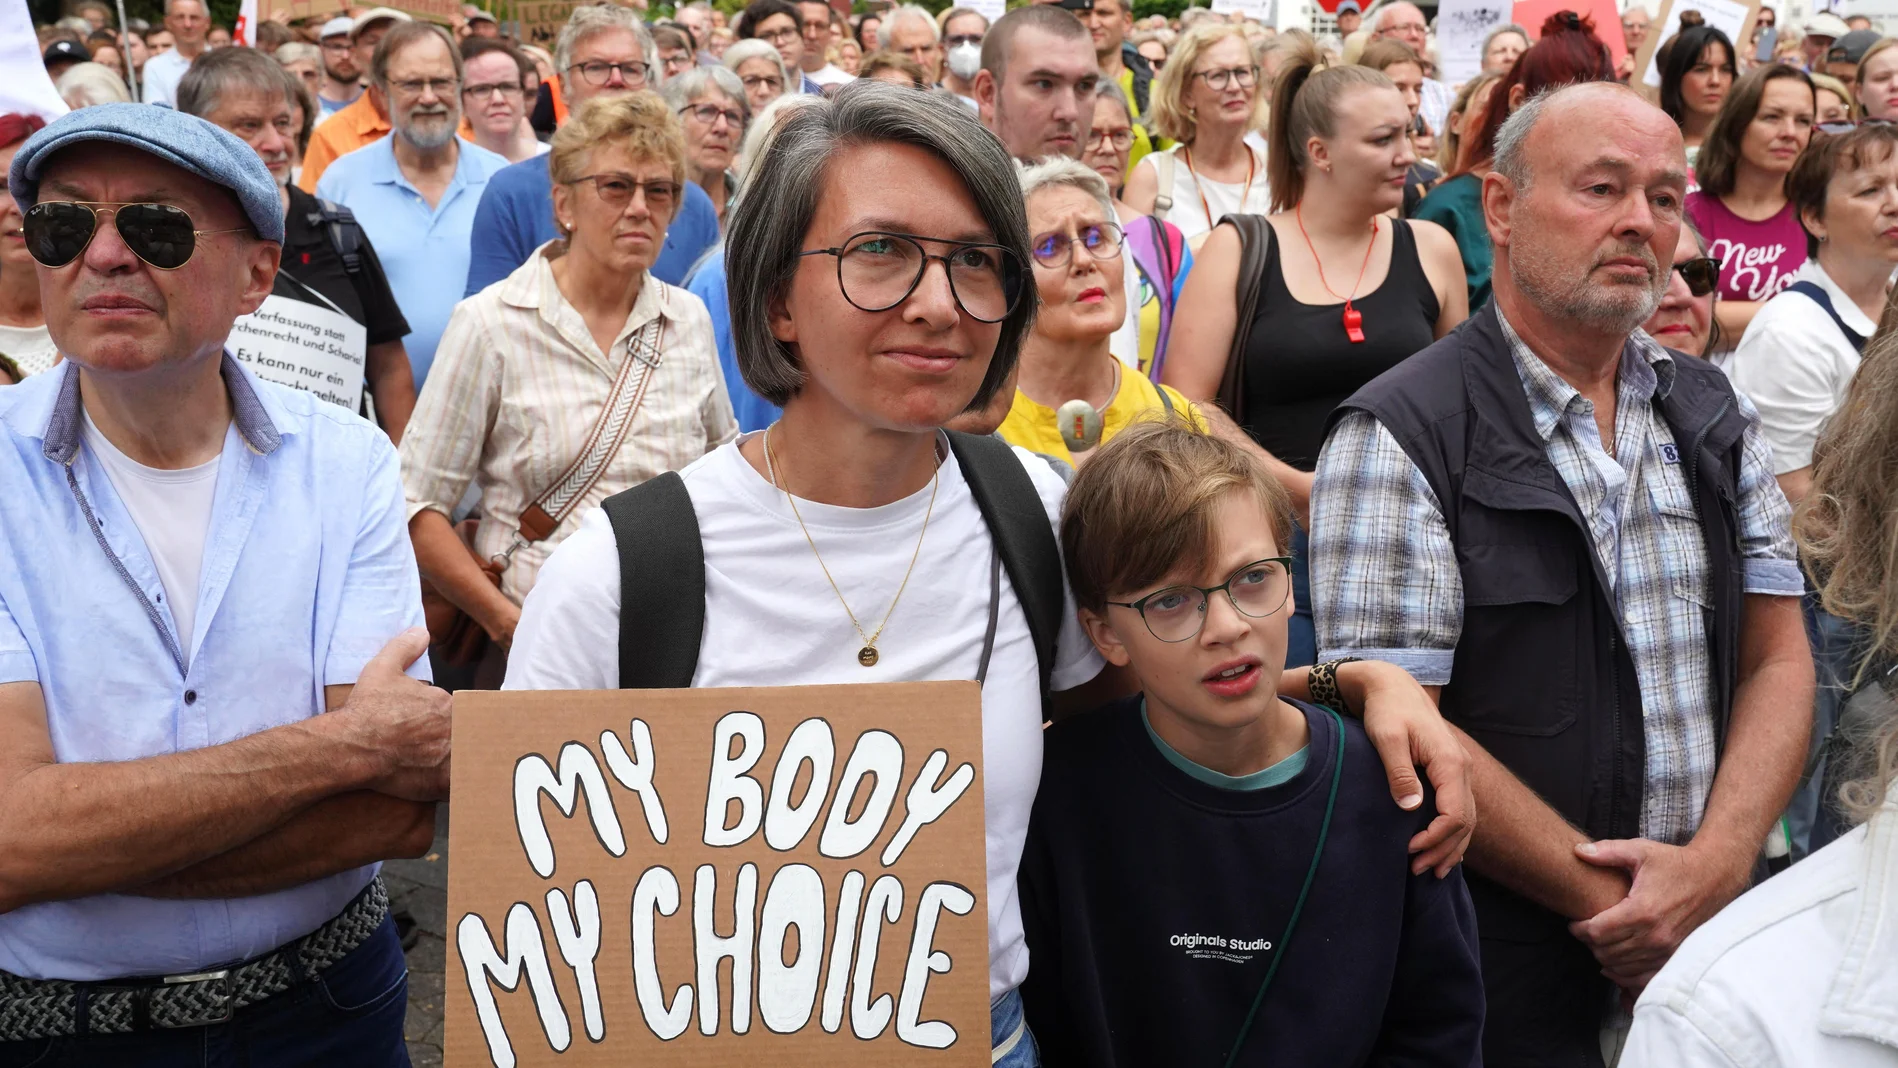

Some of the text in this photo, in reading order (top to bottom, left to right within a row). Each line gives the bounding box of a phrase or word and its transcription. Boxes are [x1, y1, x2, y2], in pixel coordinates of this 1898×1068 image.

[1707, 239, 1786, 273] New
[1730, 266, 1799, 301] Yo
[253, 310, 346, 342] Verfassung statt
[303, 341, 325, 351] und
[237, 348, 252, 361] Es
[257, 352, 296, 372] kann
[300, 365, 323, 379] nur
[326, 372, 344, 387] ein
[513, 711, 976, 879] MY BODY
[1170, 933, 1272, 951] Originals Studio
[456, 861, 976, 1068] MY CHOICE
